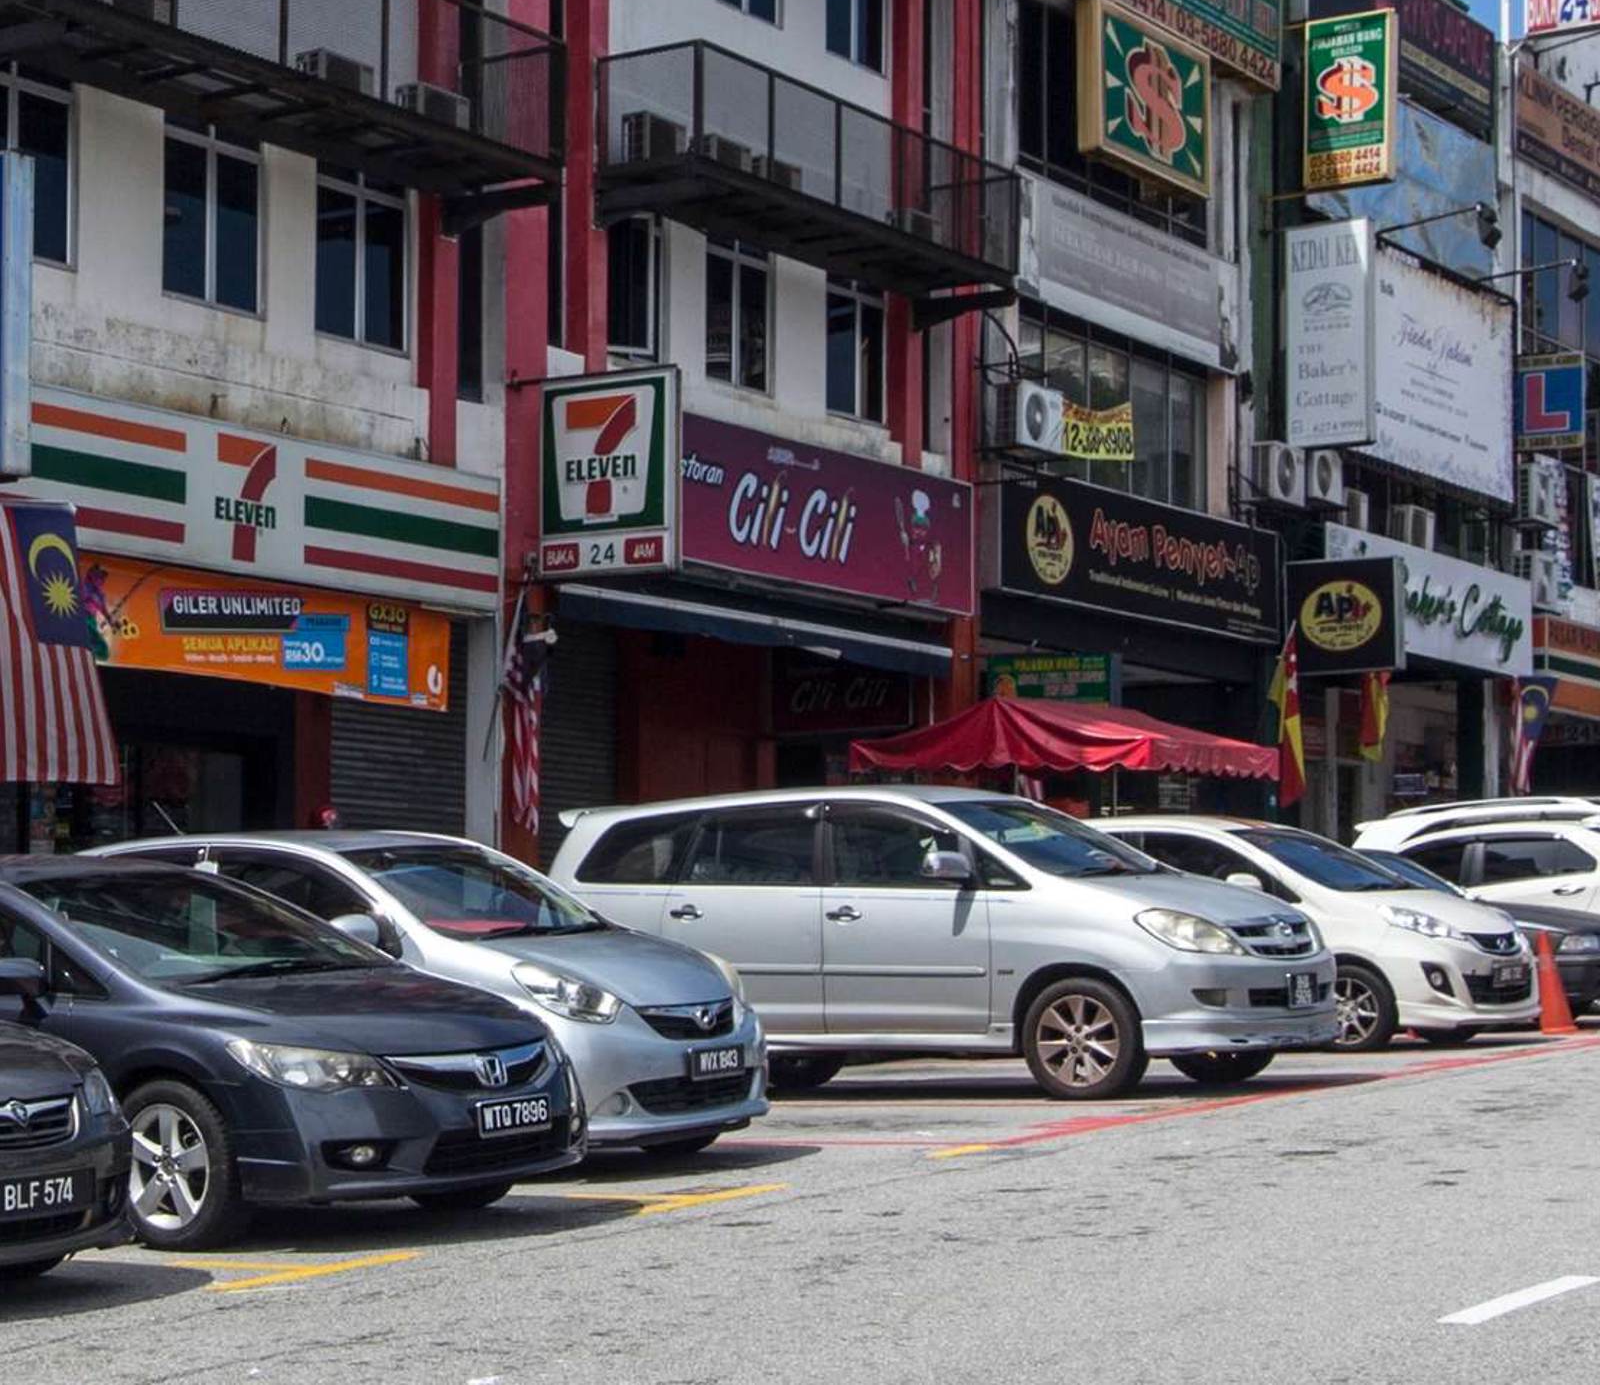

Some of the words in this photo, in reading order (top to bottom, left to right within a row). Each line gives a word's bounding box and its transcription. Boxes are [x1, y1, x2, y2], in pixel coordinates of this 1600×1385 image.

[1177, 8, 1237, 61] 03-5880
[1240, 46, 1276, 79] 4424
[1355, 147, 1381, 162] 4414
[1355, 161, 1381, 176] 4424
[1299, 359, 1357, 381] Baker's
[1524, 372, 1570, 433] L
[680, 453, 725, 486] storan
[729, 470, 789, 550] Cili
[799, 487, 857, 564] Cili
[1090, 507, 1148, 566] Ayam
[590, 543, 617, 566] 24
[173, 595, 218, 615] GILER
[221, 596, 301, 616] UNLIMITED
[1400, 560, 1456, 626] aker's
[1457, 582, 1524, 664] Cottage
[182, 637, 226, 652] SEMUA
[227, 637, 279, 653] APLIKASI
[512, 1099, 548, 1125] 7896
[4, 1181, 40, 1212] BLF
[44, 1176, 74, 1206] 574
